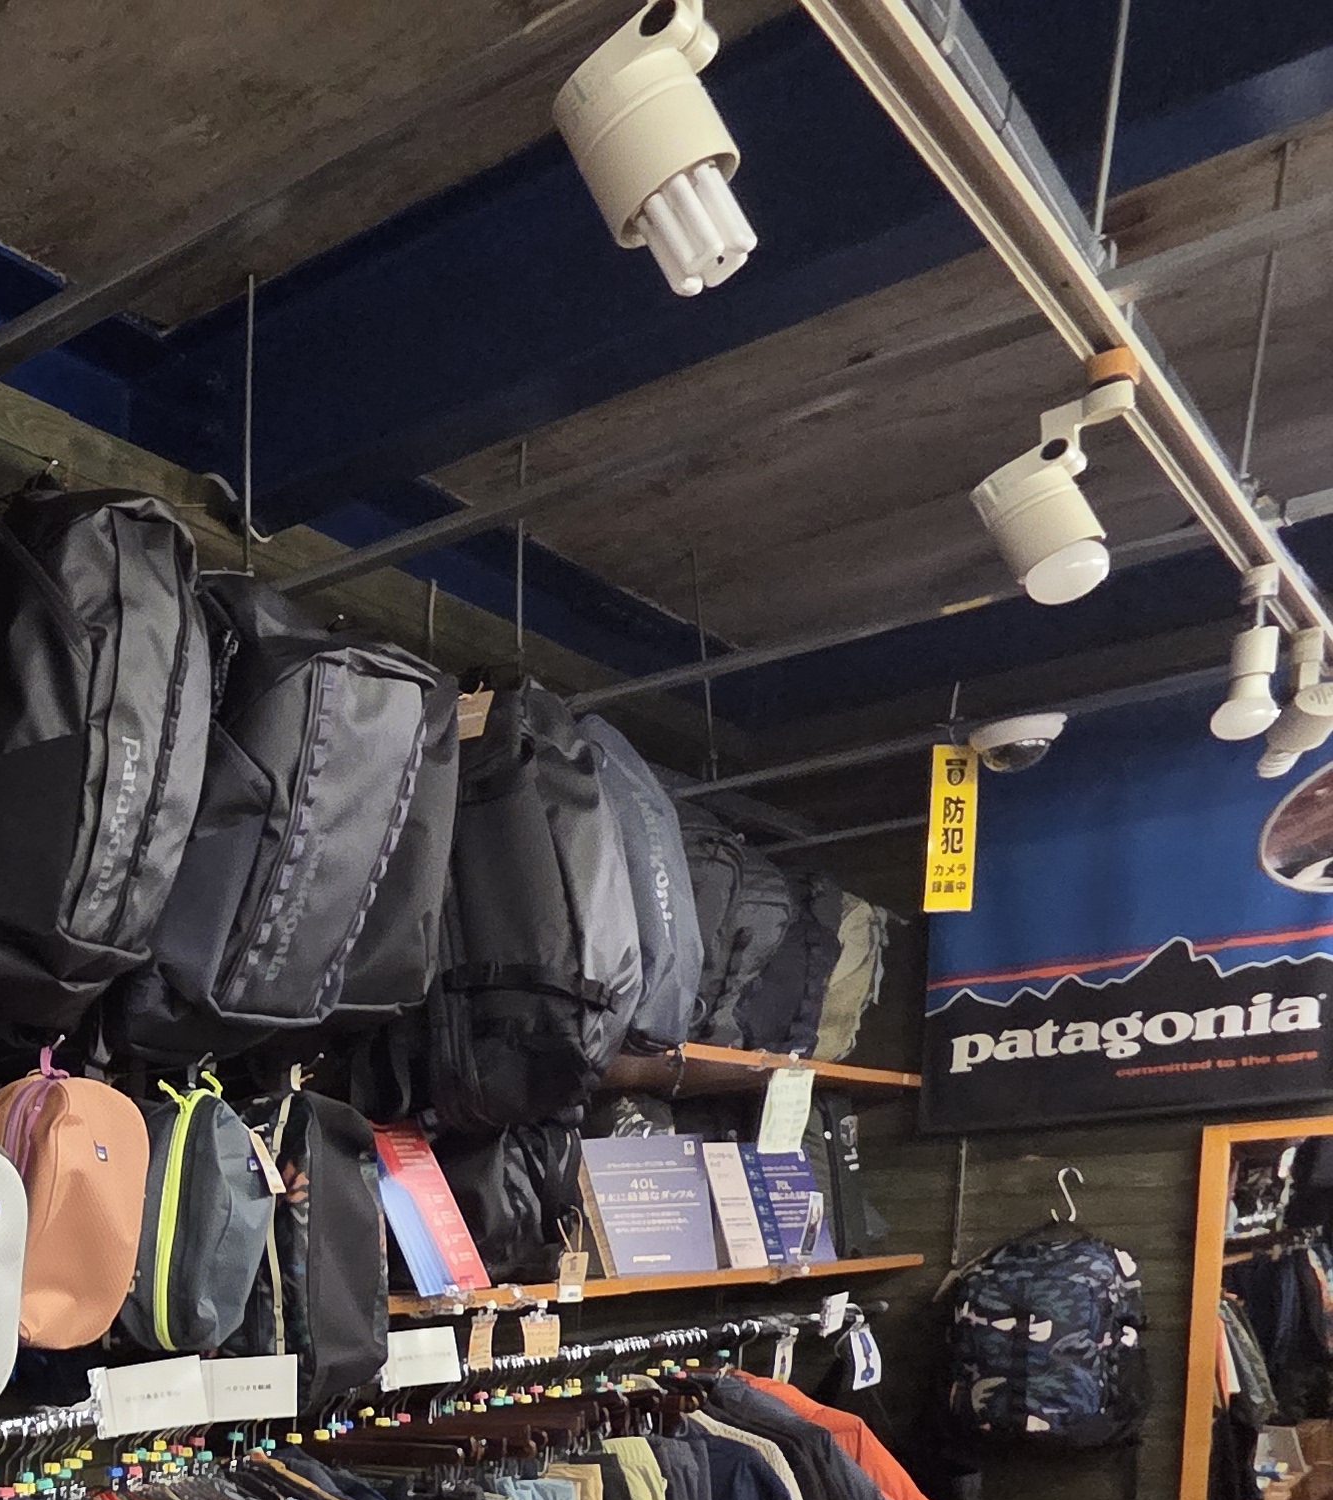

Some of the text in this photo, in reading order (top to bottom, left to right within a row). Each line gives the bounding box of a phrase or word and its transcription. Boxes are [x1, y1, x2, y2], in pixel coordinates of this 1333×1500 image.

[940, 797, 965, 855] 防犯
[933, 863, 967, 877] カメラ
[931, 880, 967, 894] 録画中
[949, 993, 1321, 1074] patagonia
[630, 1178, 659, 1189] 40L
